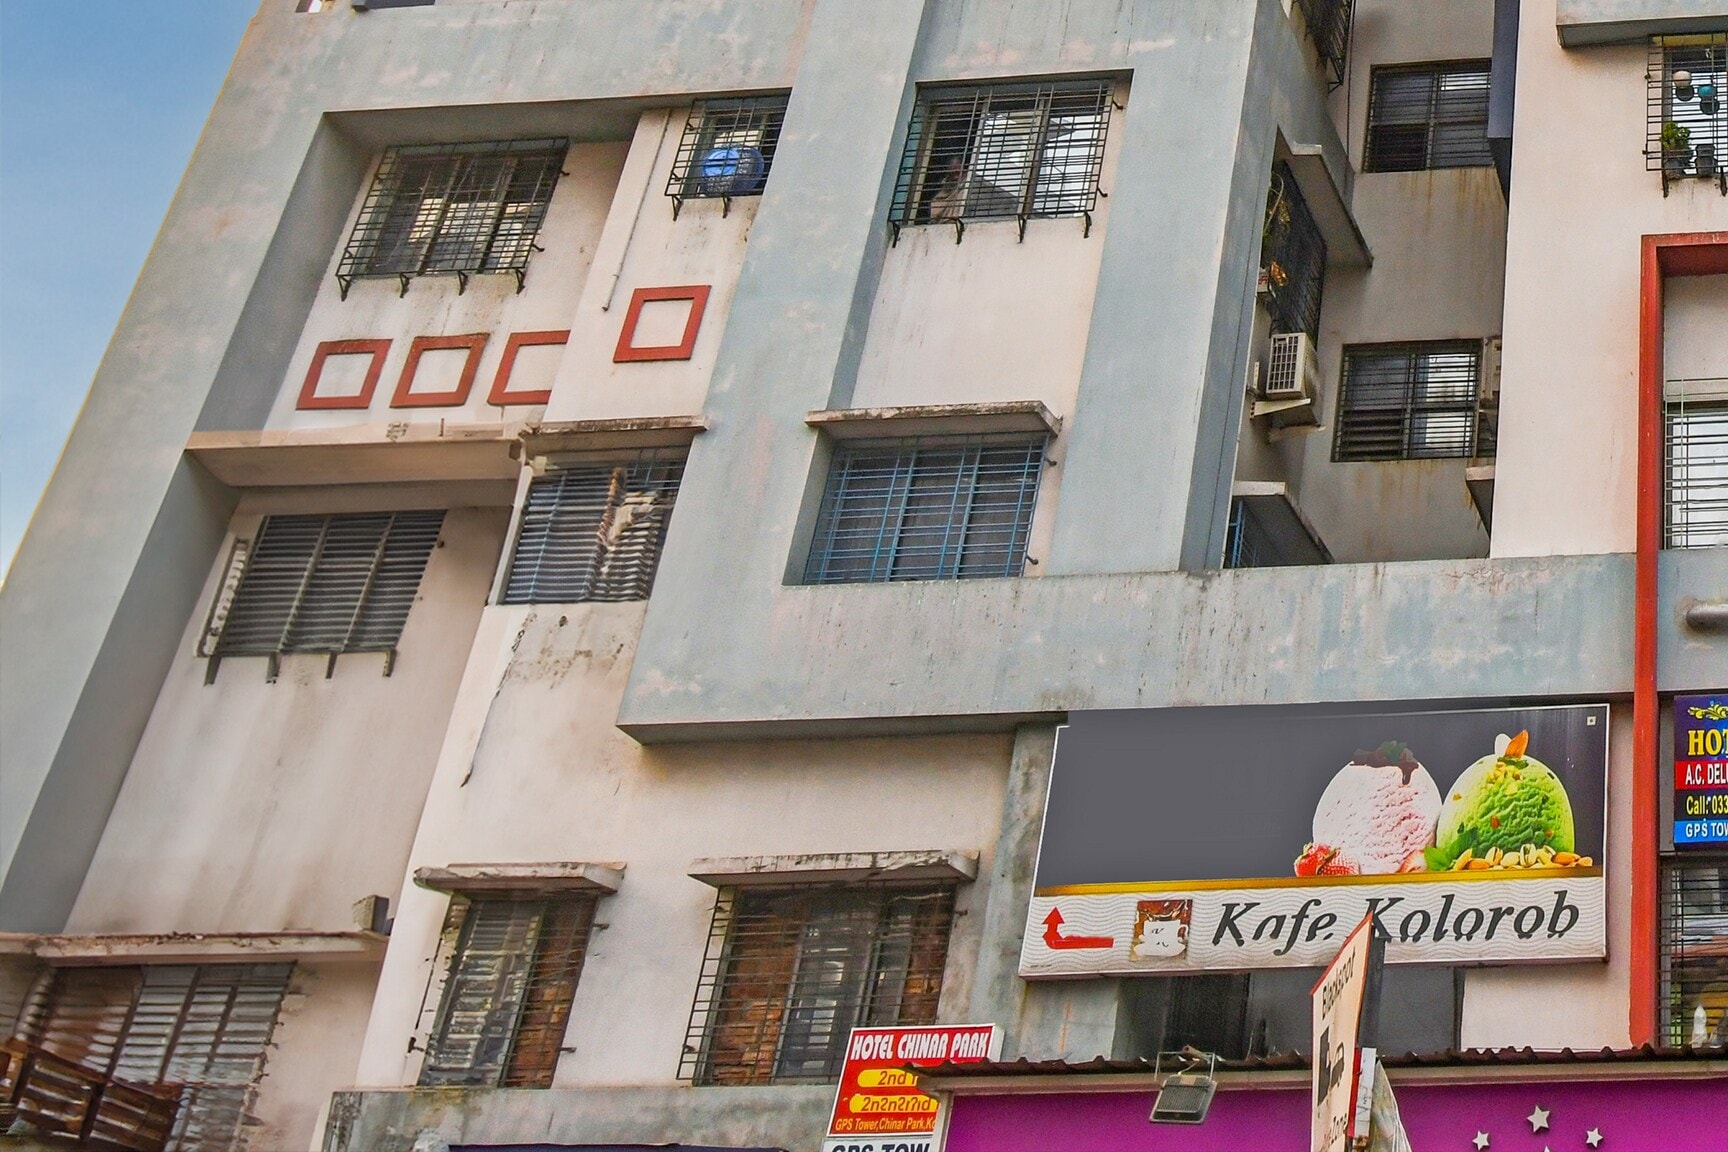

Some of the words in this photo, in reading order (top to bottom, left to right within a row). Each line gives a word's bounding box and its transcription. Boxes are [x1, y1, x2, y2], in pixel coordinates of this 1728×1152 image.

[1686, 764, 1704, 785] A.C.
[1686, 823, 1708, 837] GPS
[1212, 899, 1337, 956] Kafe
[850, 1034, 894, 1060] HOTEL
[897, 1033, 948, 1058] CHINAR
[950, 1032, 990, 1058] PARK
[835, 1118, 853, 1131] GPS
